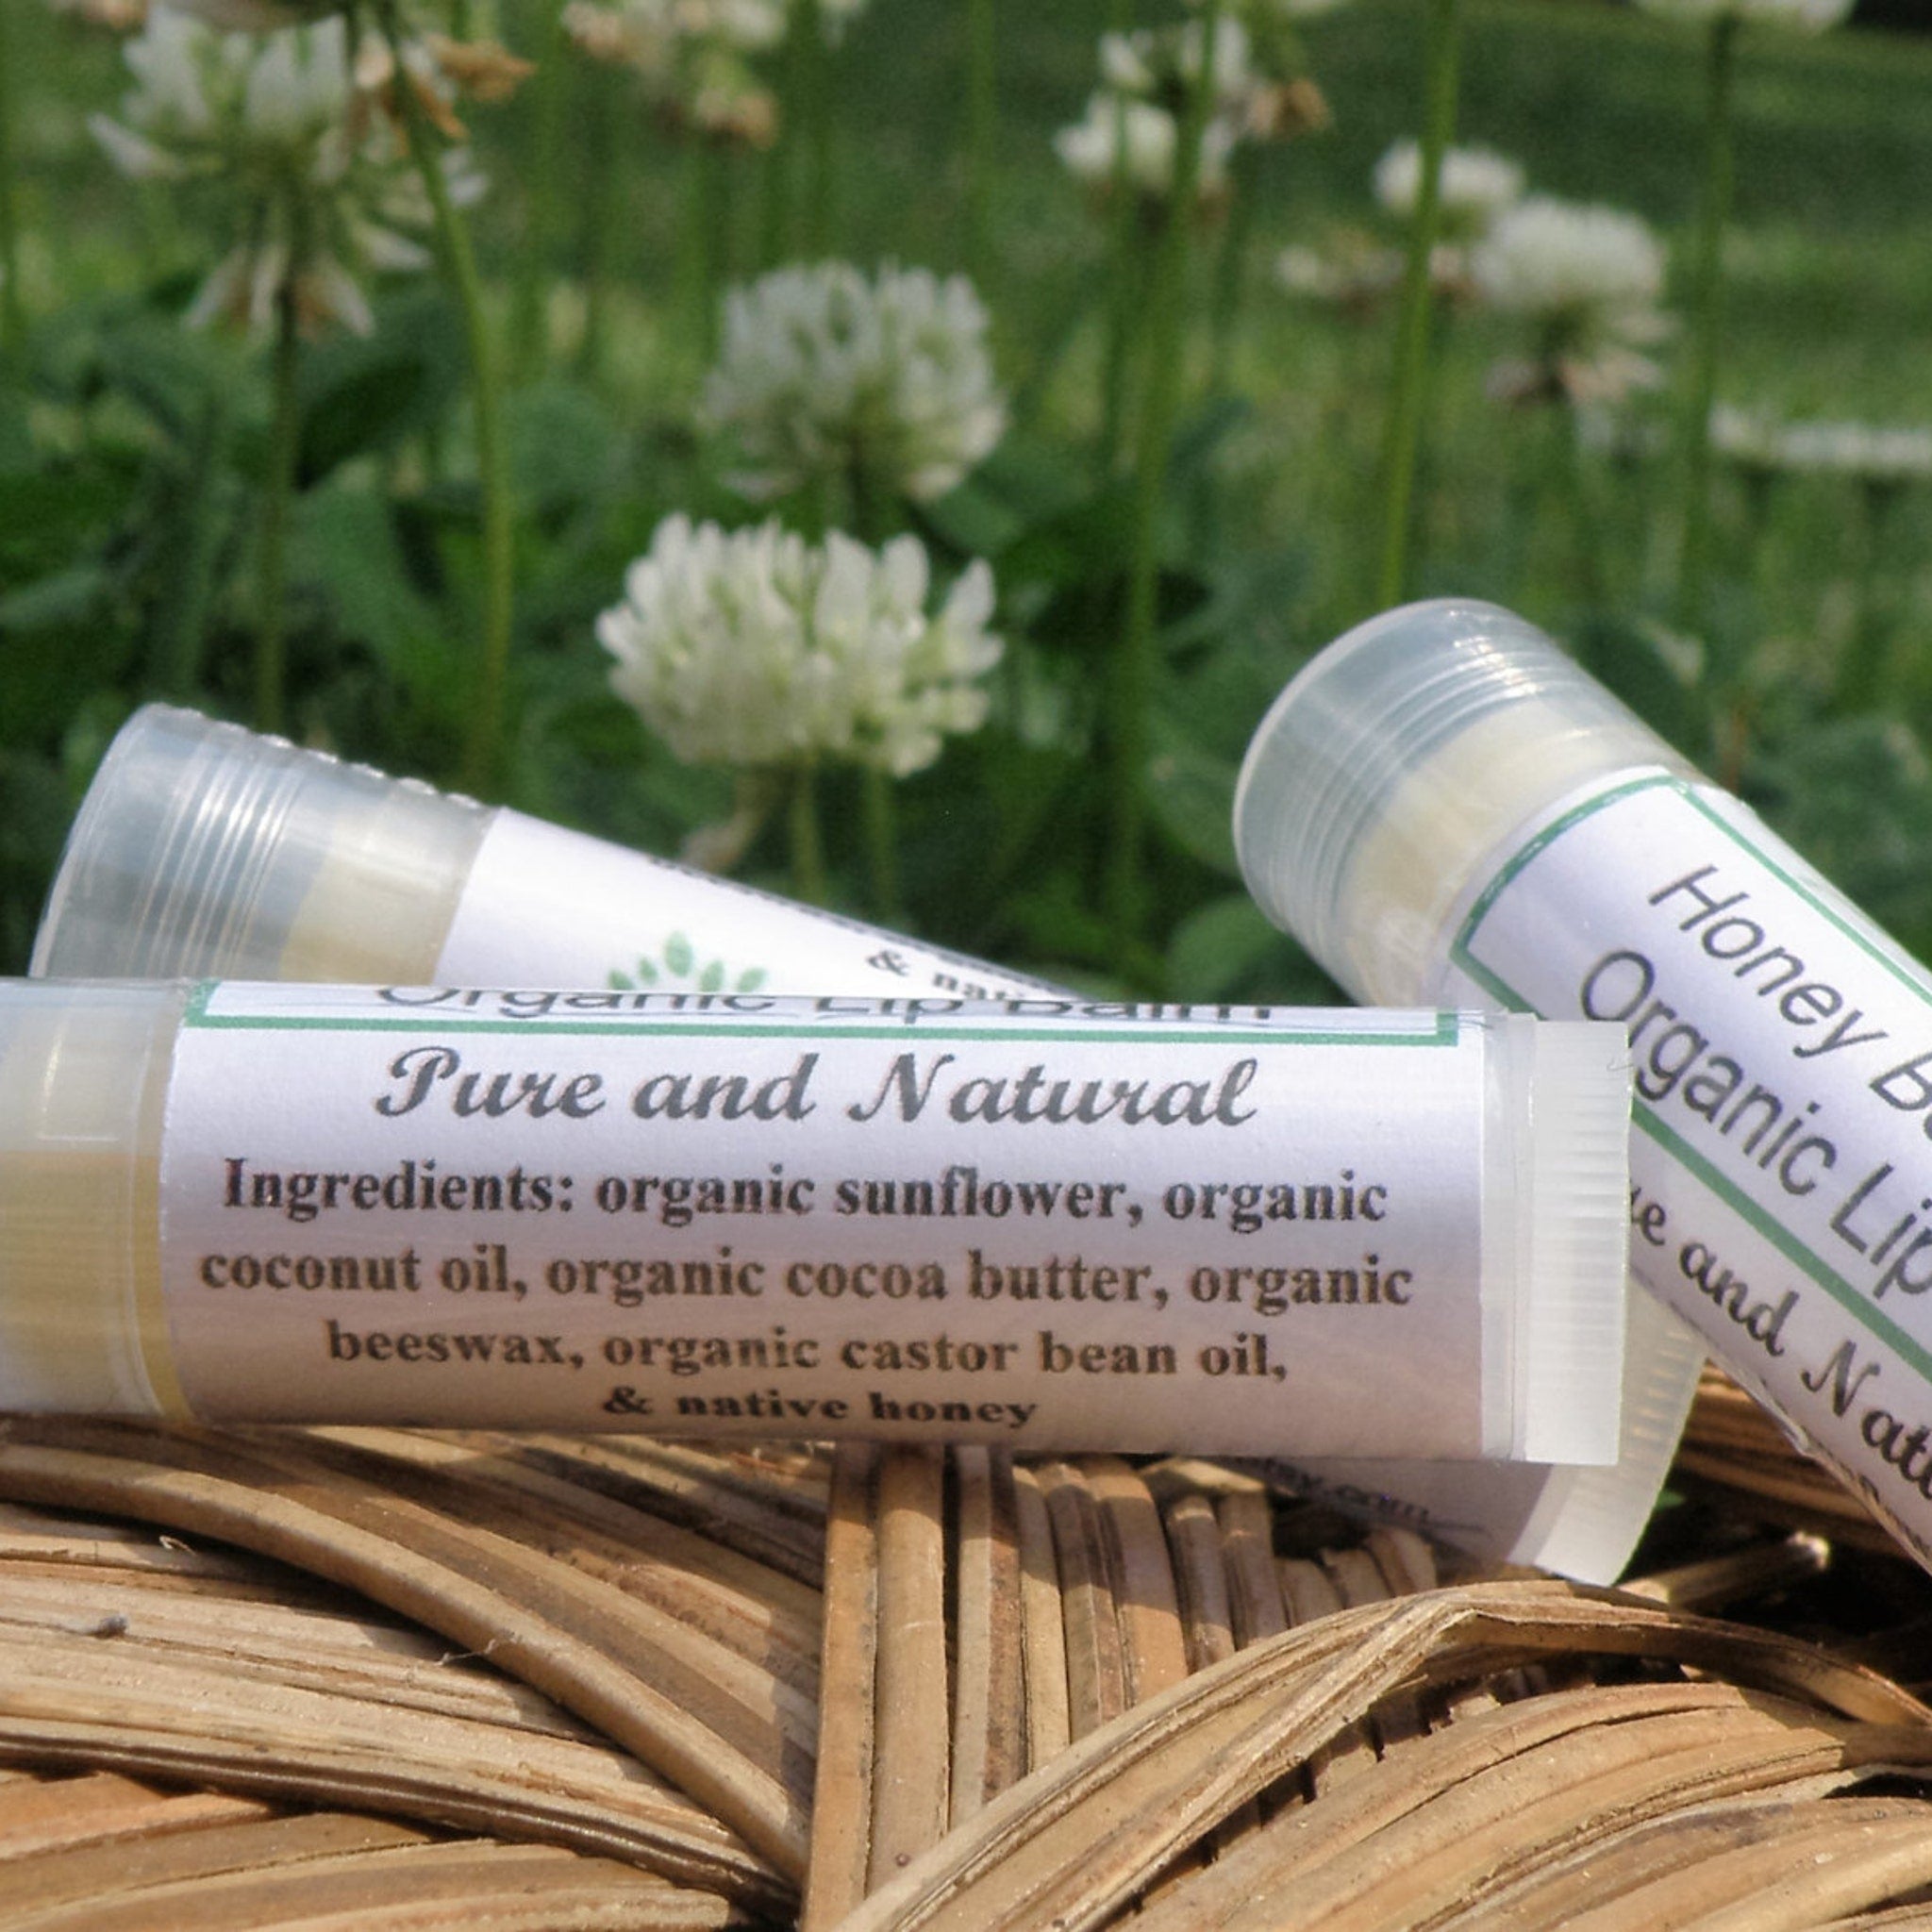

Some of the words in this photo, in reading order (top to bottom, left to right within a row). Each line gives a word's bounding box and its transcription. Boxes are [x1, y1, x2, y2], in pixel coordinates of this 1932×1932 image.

[1647, 864, 1890, 1059] Honey
[375, 1046, 607, 1120] Pure
[630, 1053, 820, 1123] and
[849, 1051, 1258, 1126] Natural
[1580, 950, 1838, 1195] Organic
[223, 1158, 574, 1224] Ingredients:
[597, 1163, 815, 1227] organic
[834, 1166, 1143, 1228] sunflower,
[1163, 1170, 1389, 1234] organic
[201, 1247, 422, 1291] coconut
[441, 1243, 529, 1300] oil,
[546, 1245, 767, 1307] organic
[786, 1257, 949, 1300] cocoa
[968, 1248, 1169, 1311] butter,
[1191, 1255, 1413, 1317] organic
[1679, 1242, 1801, 1357] and
[326, 1321, 585, 1370] beeswax,
[602, 1325, 821, 1376] organic
[841, 1329, 1020, 1373] castor
[1041, 1331, 1178, 1375] bean
[1199, 1333, 1289, 1382] oil,
[603, 1386, 653, 1416] &
[675, 1389, 851, 1418] native
[868, 1391, 1038, 1429] honey
